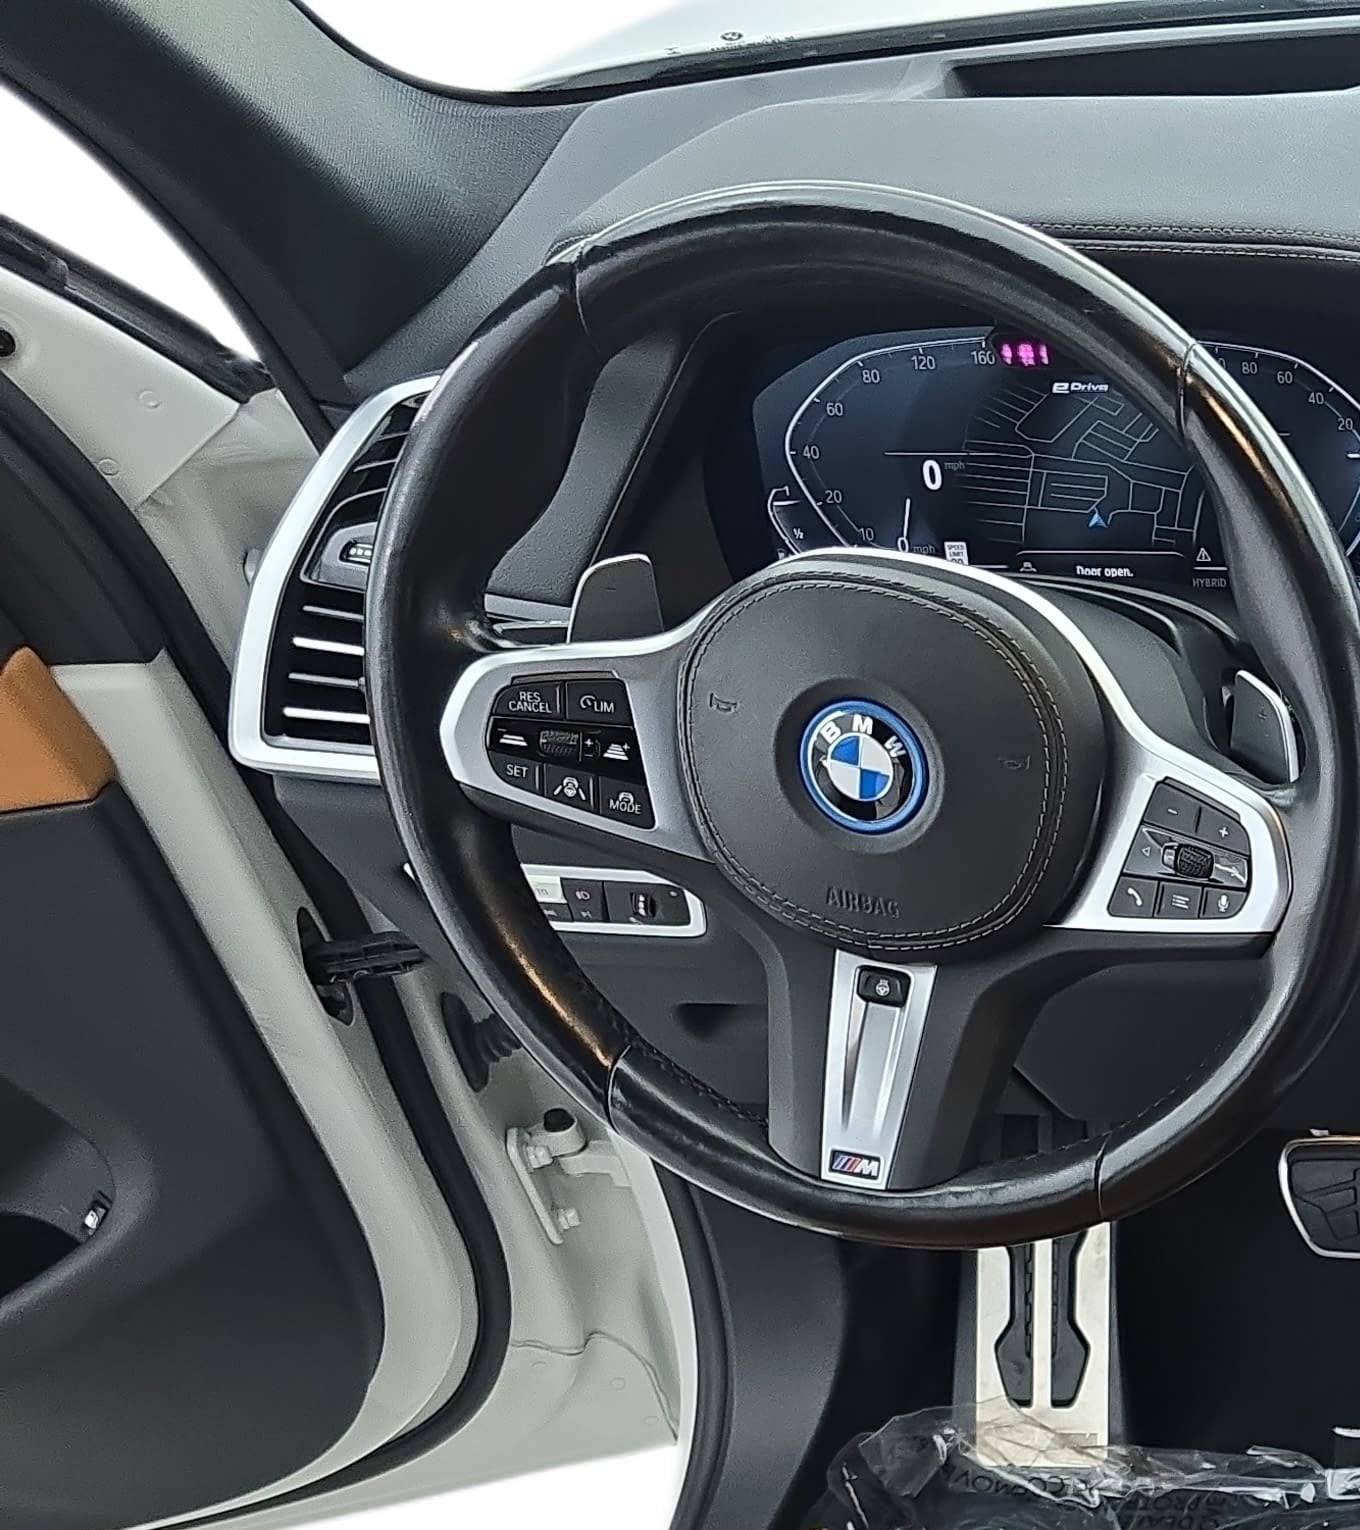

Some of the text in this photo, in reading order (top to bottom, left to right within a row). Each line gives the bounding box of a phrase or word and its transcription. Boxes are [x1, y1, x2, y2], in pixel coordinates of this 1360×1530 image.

[911, 356, 936, 370] 120
[970, 350, 996, 365] 160
[1241, 361, 1258, 375] 80
[862, 370, 881, 384] 80
[1276, 371, 1294, 385] 60
[1308, 392, 1325, 405] 40
[826, 402, 844, 416] 60
[1337, 418, 1354, 431] 20
[802, 445, 820, 460] 40
[922, 459, 965, 491] 0 mph
[824, 489, 842, 504] 20
[858, 527, 874, 542] 10
[897, 536, 936, 554] 0 mph
[1103, 567, 1134, 578] open.
[1192, 577, 1227, 588] HYBRID
[519, 691, 541, 702] RES
[508, 700, 553, 714] CANCEL
[594, 701, 615, 713] LIM
[820, 713, 906, 758] BMW
[506, 764, 529, 778] SET
[609, 800, 641, 815] MODE
[825, 886, 900, 919] AIRBAG
